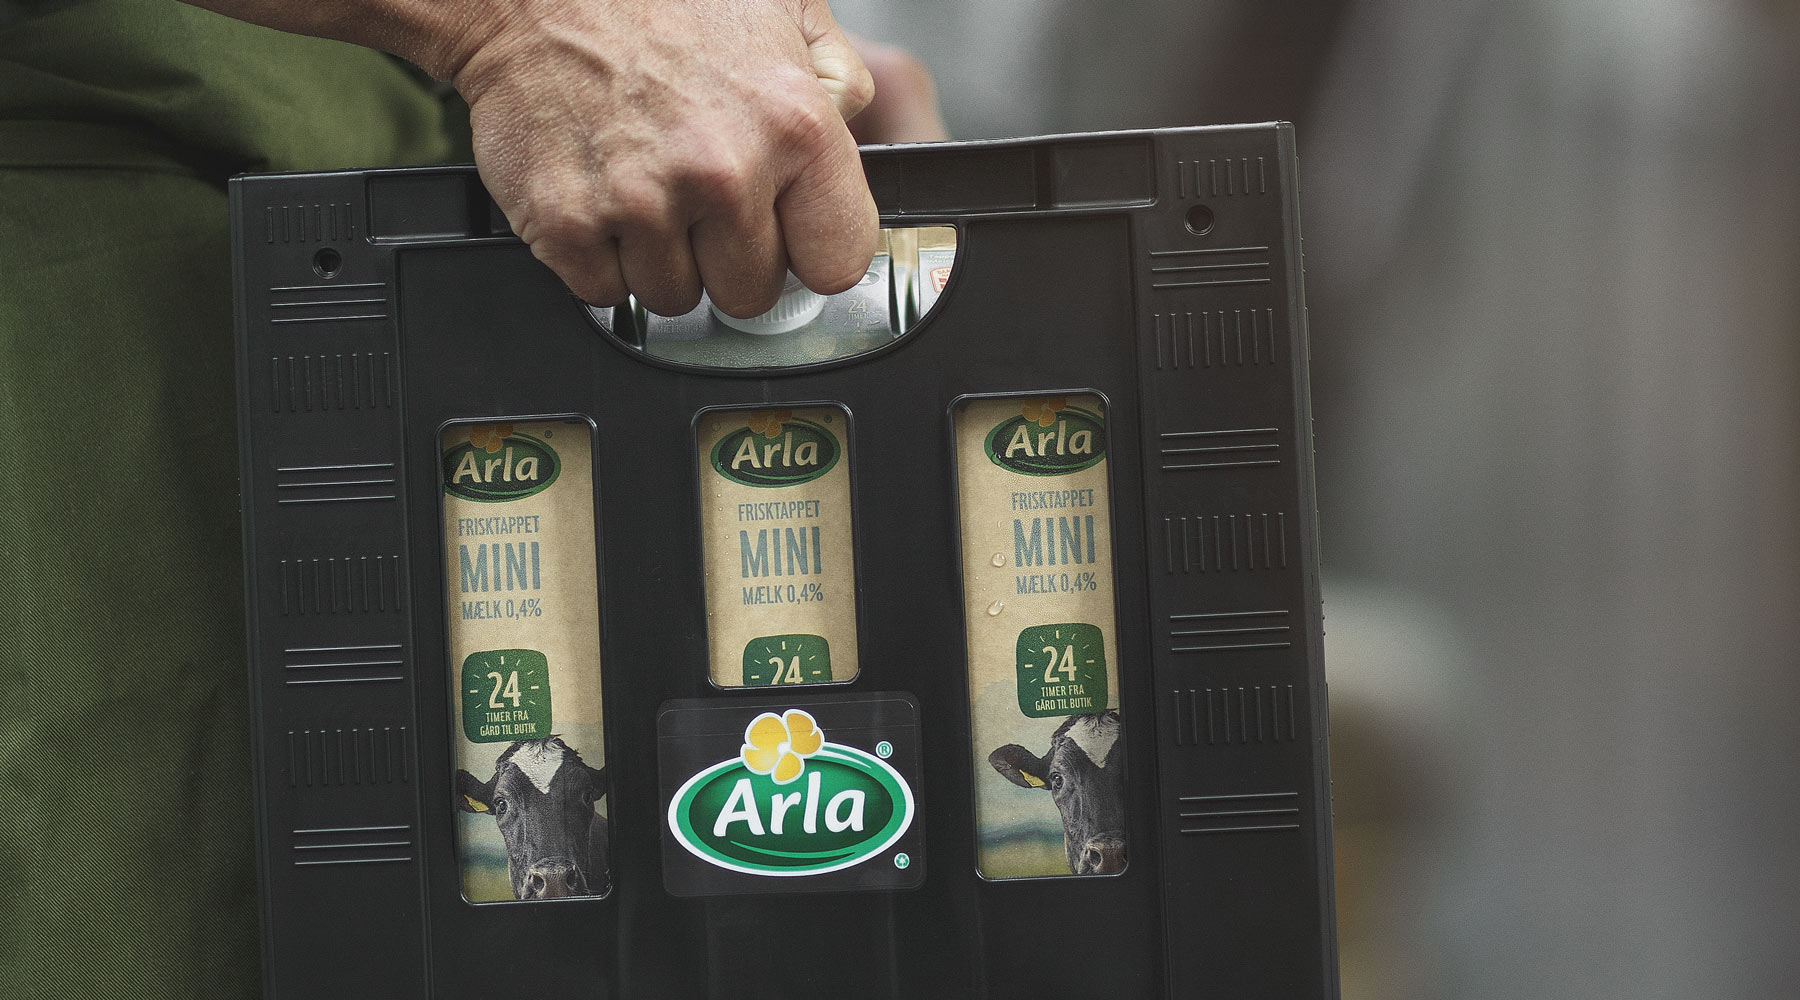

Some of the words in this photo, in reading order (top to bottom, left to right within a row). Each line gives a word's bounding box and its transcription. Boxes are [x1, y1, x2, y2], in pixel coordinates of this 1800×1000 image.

[848, 299, 867, 313] 24
[731, 431, 819, 470] Arla
[1005, 420, 1093, 458] Arla
[453, 447, 540, 484] Arla
[738, 500, 820, 521] FRISKTAPPET
[1011, 489, 1094, 511] FRISKTAPPET
[458, 515, 540, 536] FRISKTAPPET
[739, 526, 822, 578] MINI
[1013, 515, 1096, 567] MINI
[459, 541, 541, 593] MINI
[742, 585, 783, 605] MÆLK
[786, 583, 824, 605] 0,4%
[1016, 573, 1058, 595] MÆLK
[1060, 572, 1097, 594] 0,4%
[461, 600, 503, 620] MÆLK
[505, 598, 542, 620] 0,4%
[768, 655, 803, 685] 24
[1042, 645, 1077, 683] 24
[487, 670, 522, 709] 24
[1041, 685, 1067, 697] TIMER
[1068, 684, 1085, 695] FRA
[1035, 697, 1056, 711] GÅRD
[1057, 698, 1069, 709] TIL
[1069, 697, 1093, 709] BUTIK
[485, 711, 511, 722] TIMER
[512, 710, 529, 721] FRA
[501, 724, 513, 735] TIL
[514, 722, 537, 735] BUTIK
[713, 771, 866, 837] Arla
